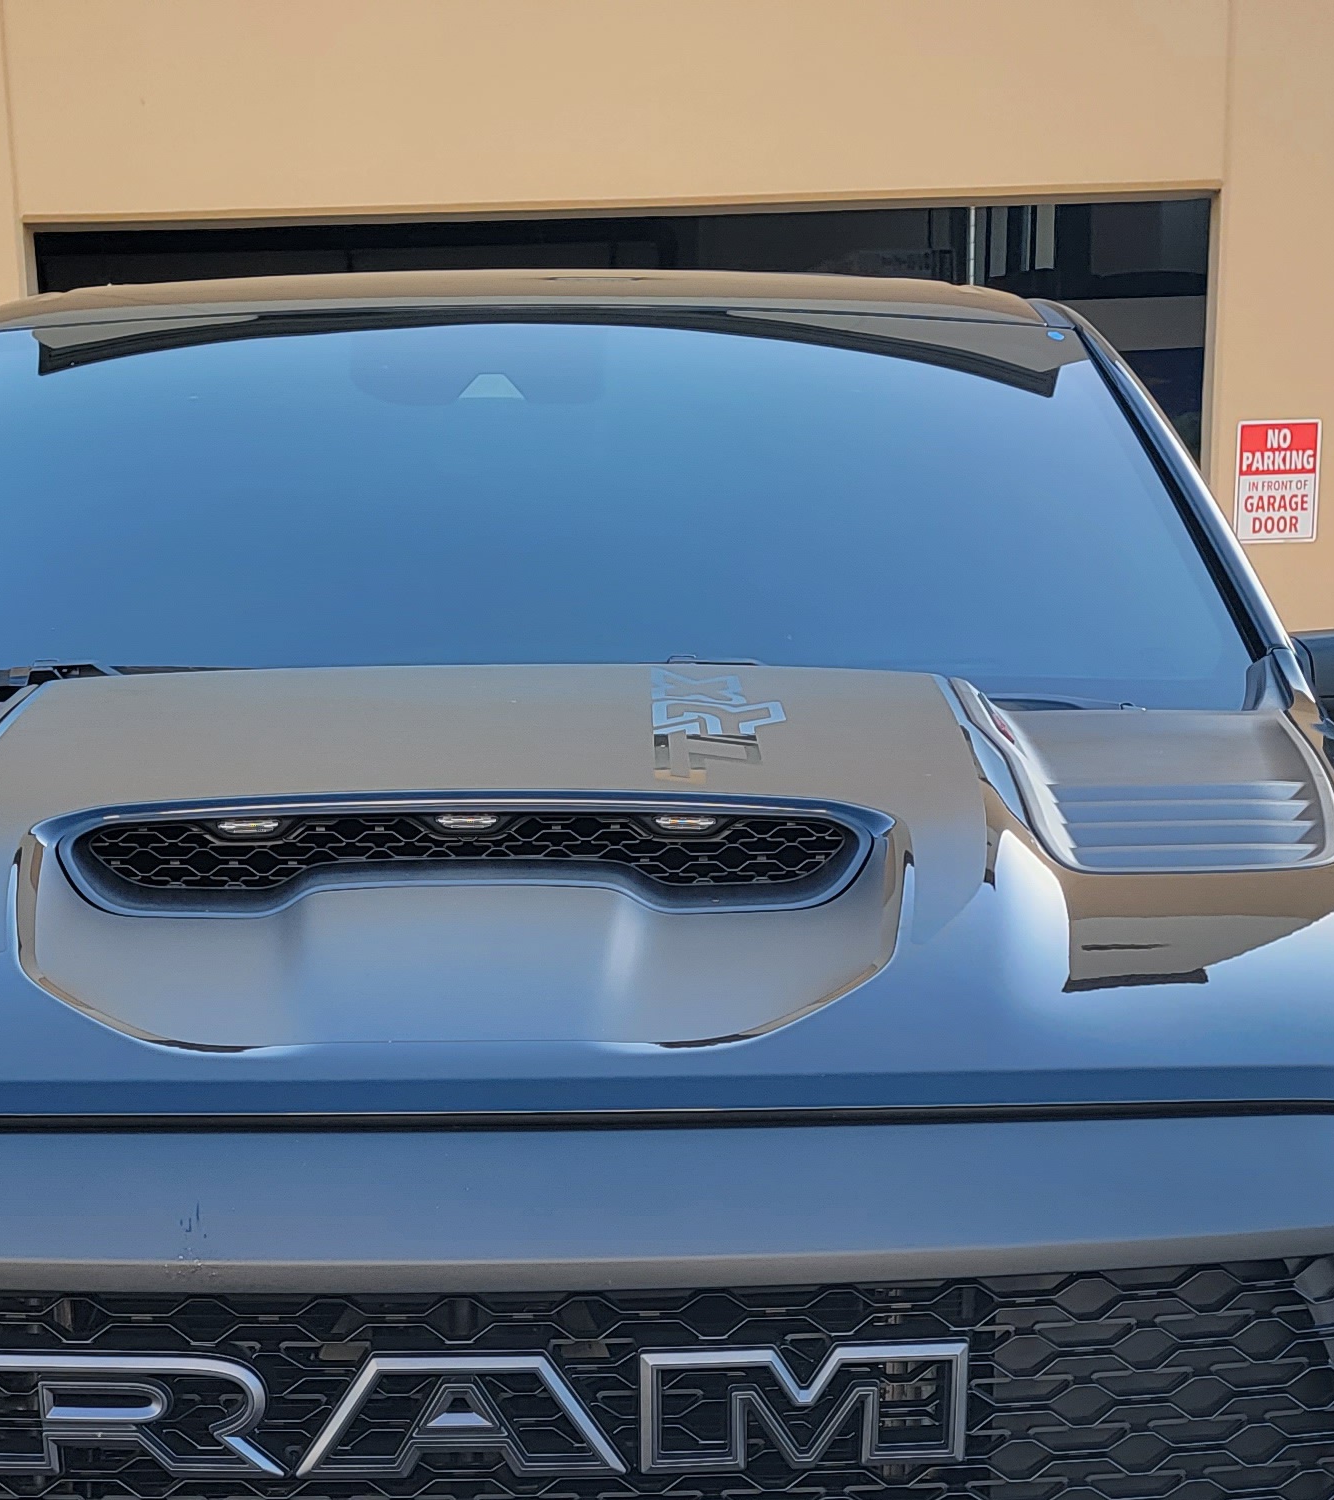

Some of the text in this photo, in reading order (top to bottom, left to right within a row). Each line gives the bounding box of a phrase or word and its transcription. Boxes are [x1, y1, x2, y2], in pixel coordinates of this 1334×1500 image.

[1266, 428, 1292, 449] NO
[1242, 450, 1315, 472] PARKING
[1248, 480, 1309, 492] IN FRONT OF
[1244, 494, 1309, 513] GARAGE
[1252, 516, 1299, 534] DOOR
